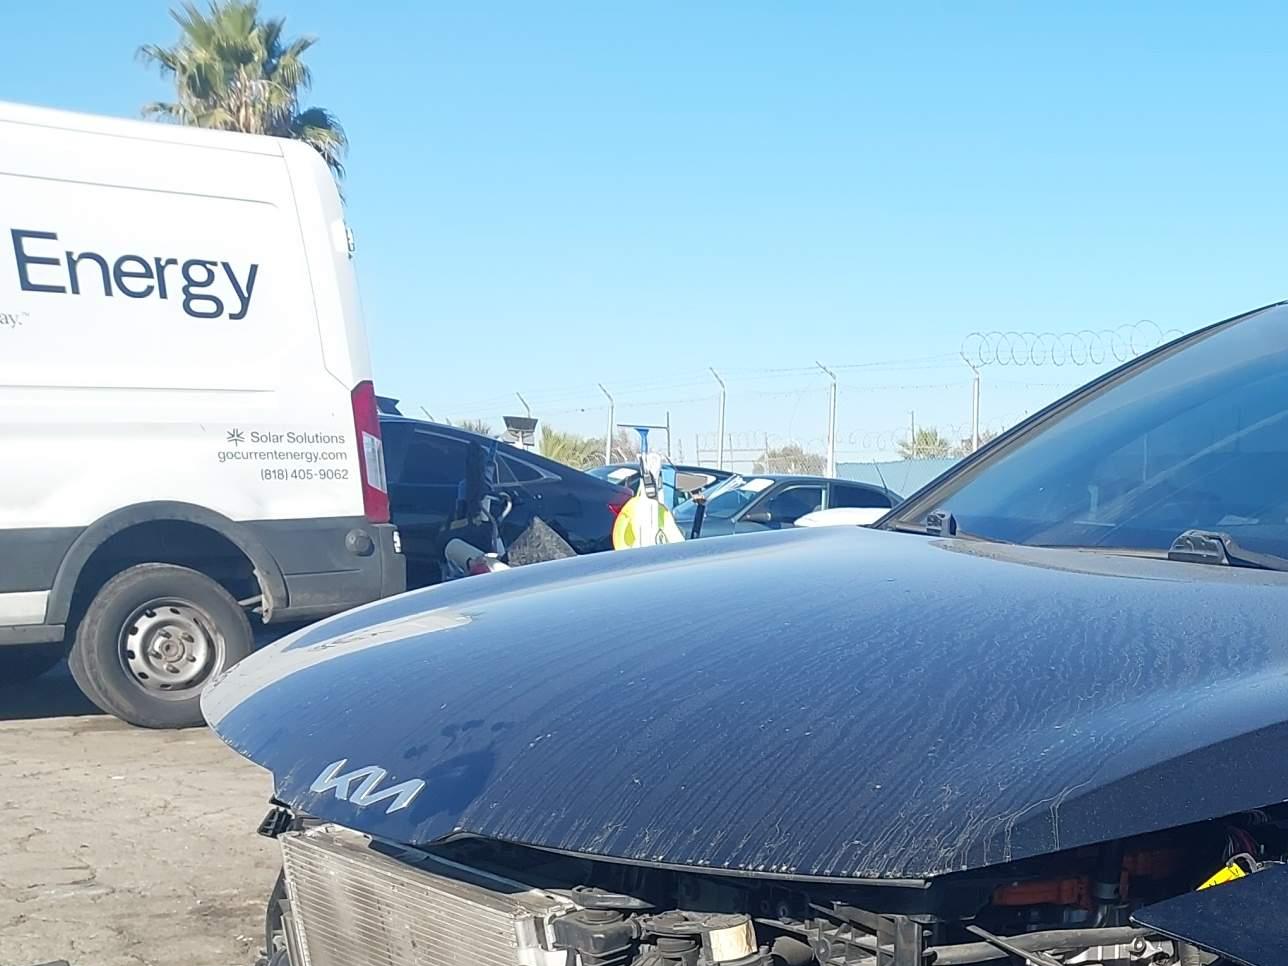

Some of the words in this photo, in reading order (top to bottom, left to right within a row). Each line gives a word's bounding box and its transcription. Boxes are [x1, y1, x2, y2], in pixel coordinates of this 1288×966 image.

[10, 228, 259, 320] Energy
[250, 431, 285, 444] Solar
[286, 431, 346, 444] Solutions
[217, 450, 348, 463] gocurrentenergy.com
[260, 468, 289, 481] (818)
[290, 468, 349, 481] 405-9062
